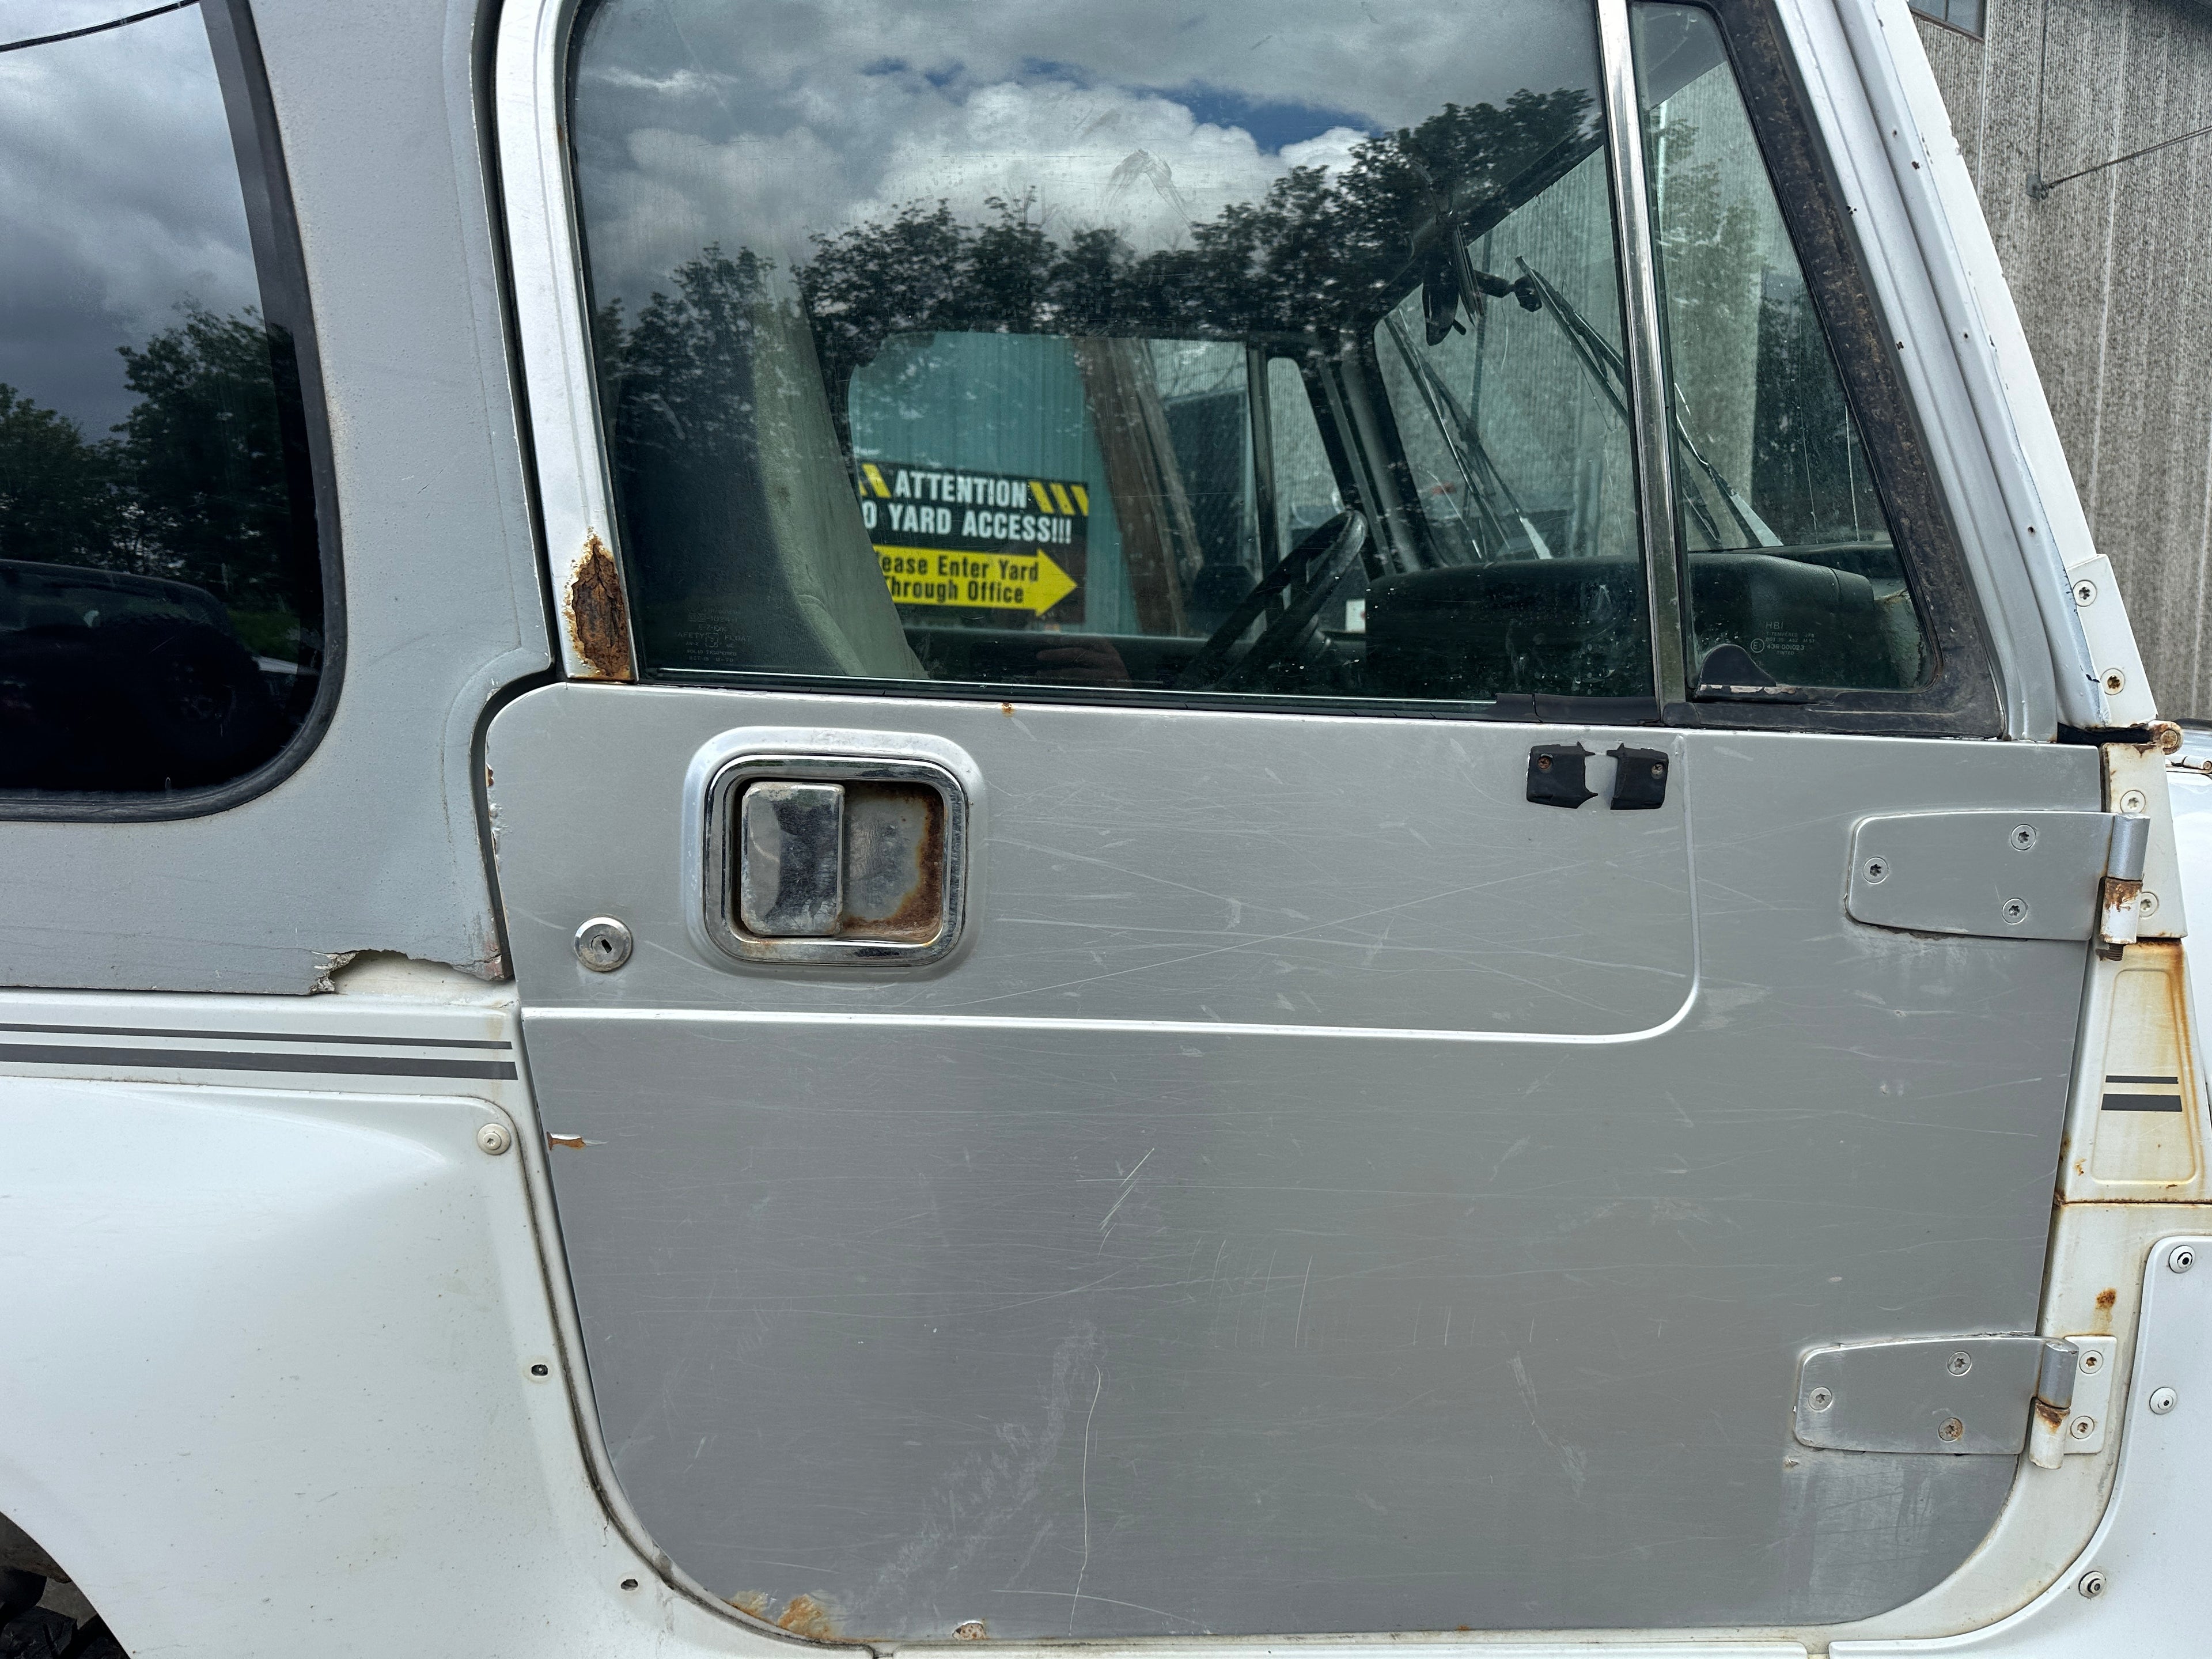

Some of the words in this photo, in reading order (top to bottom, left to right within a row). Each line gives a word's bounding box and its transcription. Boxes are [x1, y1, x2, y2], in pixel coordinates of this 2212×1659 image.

[894, 469, 1027, 509] ATTENTION
[862, 500, 877, 529] O
[888, 503, 952, 535] YARD
[961, 509, 1072, 544] ACCESS!!!
[876, 551, 927, 574] ease
[938, 555, 990, 578] Enter
[999, 558, 1039, 582] Yard
[968, 579, 1024, 603] Office
